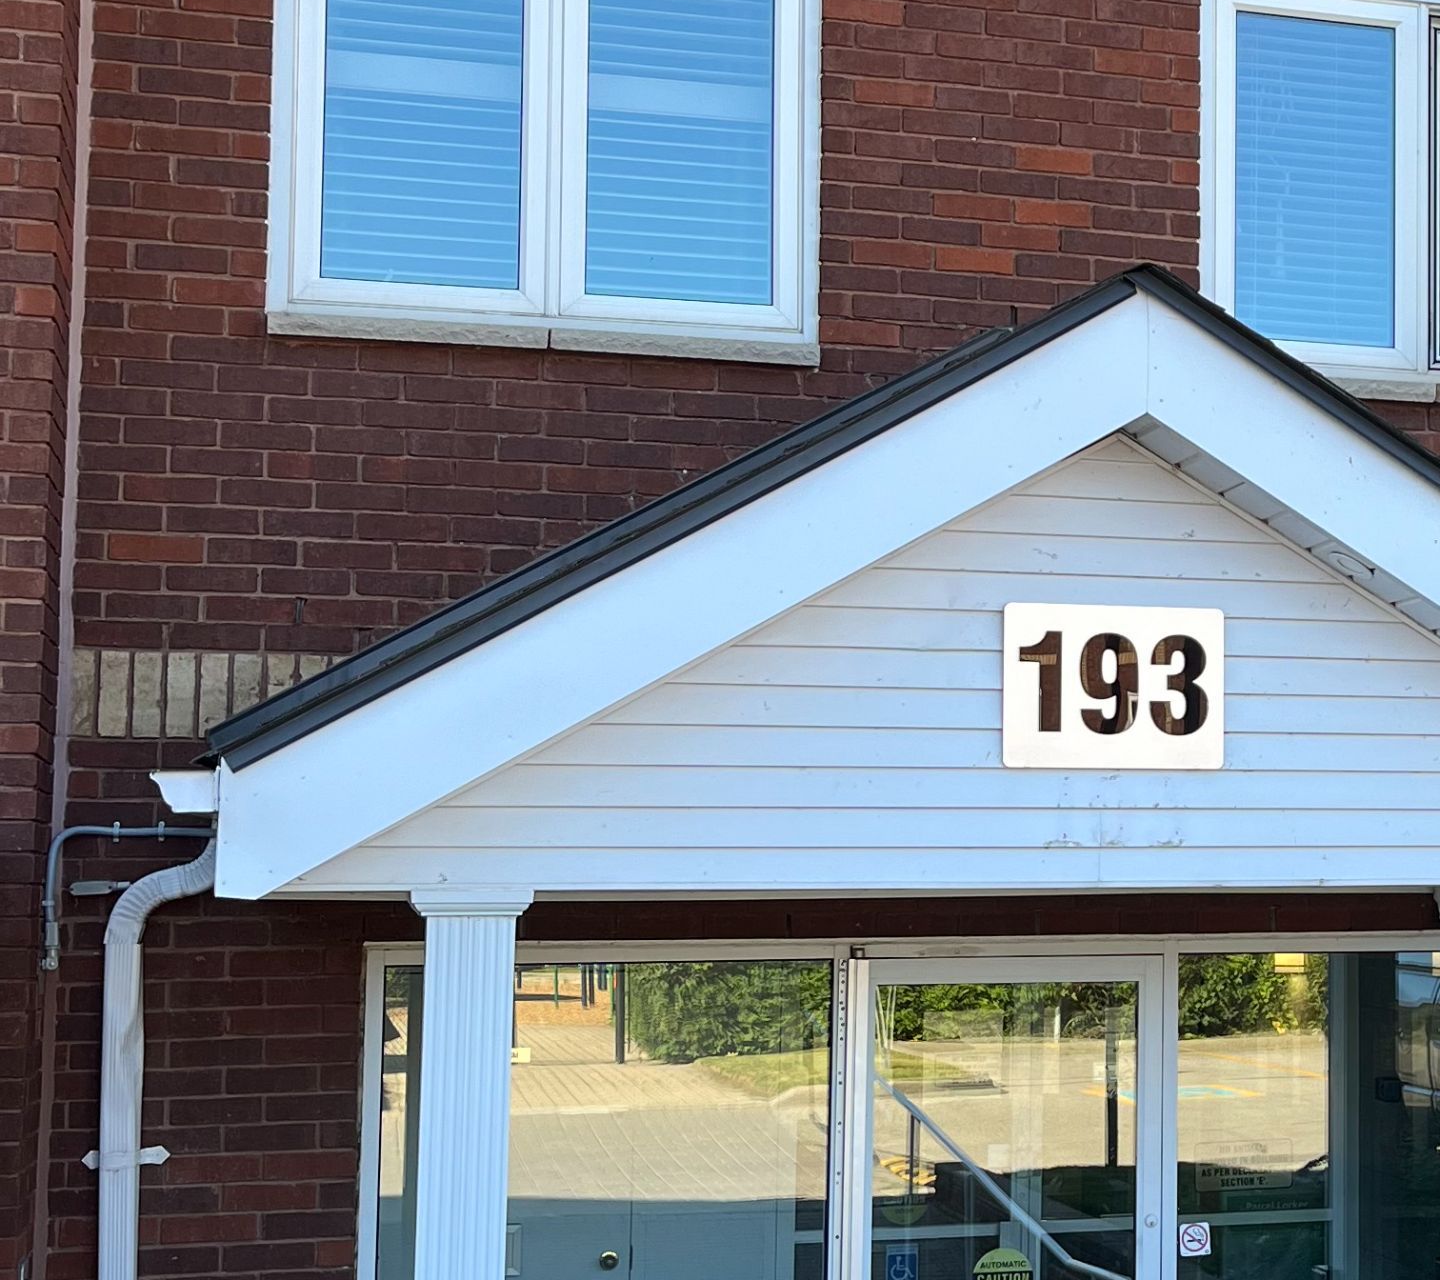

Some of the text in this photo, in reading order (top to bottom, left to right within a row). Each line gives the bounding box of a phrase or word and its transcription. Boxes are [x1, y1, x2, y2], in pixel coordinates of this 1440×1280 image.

[1019, 631, 1208, 736] 193
[1201, 1168, 1212, 1177] AS
[1221, 1177, 1255, 1187] SECTION
[980, 1260, 1027, 1269] AUTOMATIC
